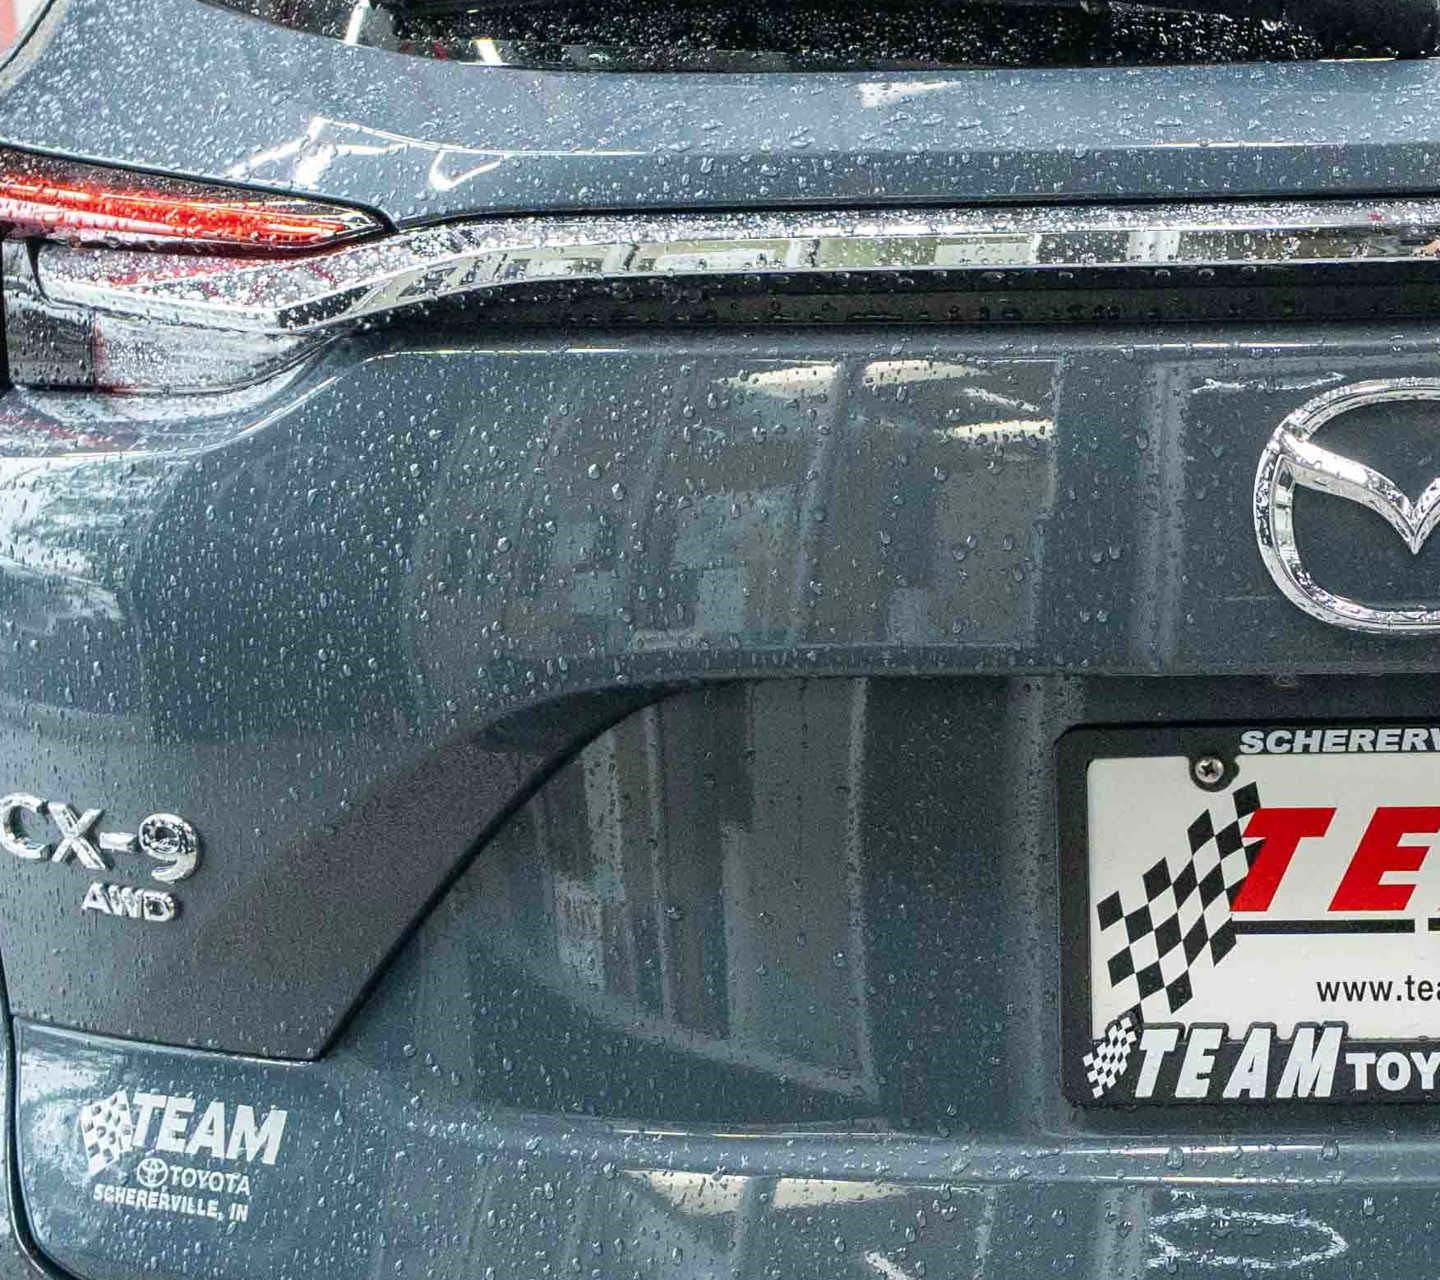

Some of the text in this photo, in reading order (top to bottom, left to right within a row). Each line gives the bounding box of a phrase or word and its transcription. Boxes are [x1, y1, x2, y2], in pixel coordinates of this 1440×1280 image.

[80, 882, 179, 922] AWD
[1135, 1026, 1346, 1099] TEAM
[131, 1092, 288, 1165] TEAM
[169, 1165, 251, 1196] TOYOTA
[93, 1183, 249, 1222] SCHERERVILLE, IN
